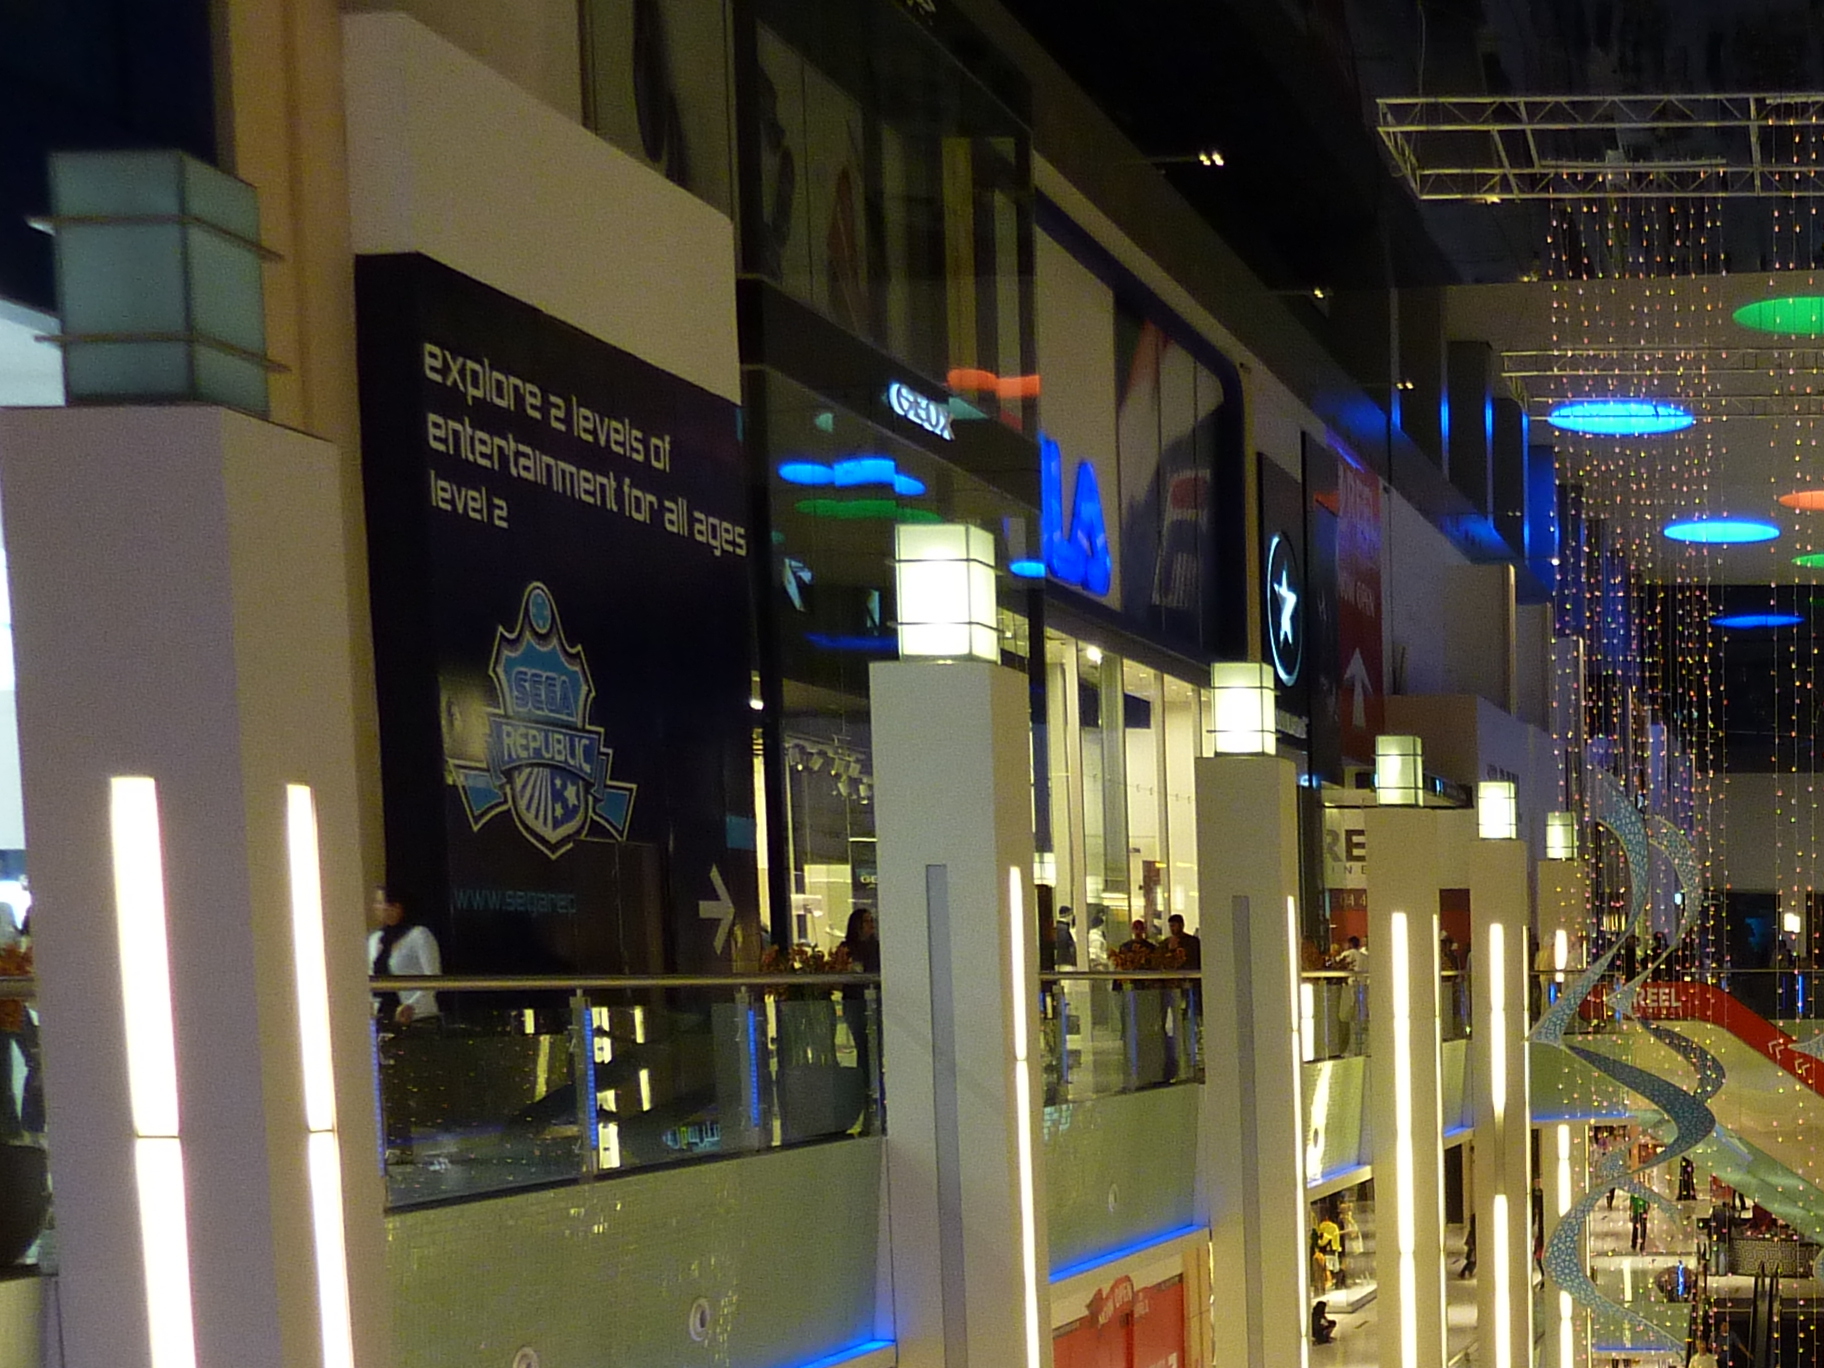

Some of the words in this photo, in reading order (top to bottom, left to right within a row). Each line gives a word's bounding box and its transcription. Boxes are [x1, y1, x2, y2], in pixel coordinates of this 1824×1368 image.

[423, 342, 542, 420] explore
[547, 393, 567, 432] 2
[571, 395, 645, 463] levels
[649, 435, 671, 473] of
[888, 381, 955, 441] GEOX
[427, 412, 618, 512] entertainment
[622, 476, 658, 525] for
[664, 495, 688, 538] all
[693, 511, 747, 557] ages
[429, 470, 488, 524] level
[493, 497, 509, 529] 2
[511, 667, 577, 719] SEGA
[503, 725, 592, 774] REPUBLIC
[1633, 987, 1682, 1008] REEL
